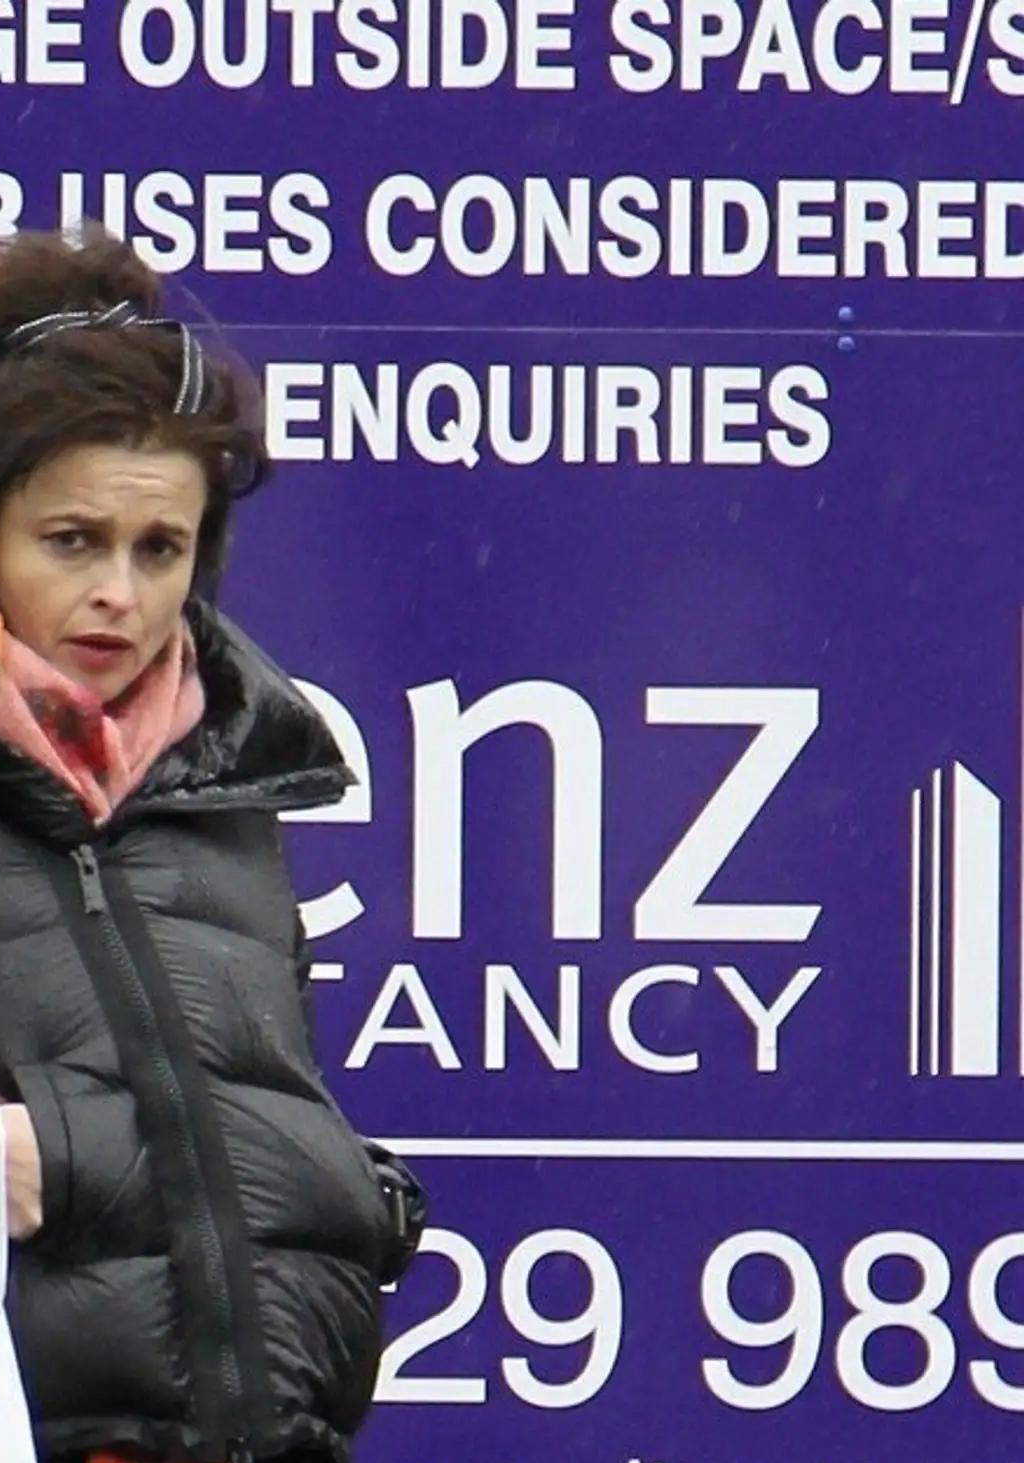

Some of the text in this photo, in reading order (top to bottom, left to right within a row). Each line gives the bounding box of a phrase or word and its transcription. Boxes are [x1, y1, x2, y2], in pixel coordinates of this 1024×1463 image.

[119, 0, 576, 90] OUTSIDE
[365, 174, 1024, 279] CONSIDERED
[265, 362, 831, 469] ENQUIRIES
[308, 962, 823, 1073] ANCY
[372, 1228, 623, 1408] 29
